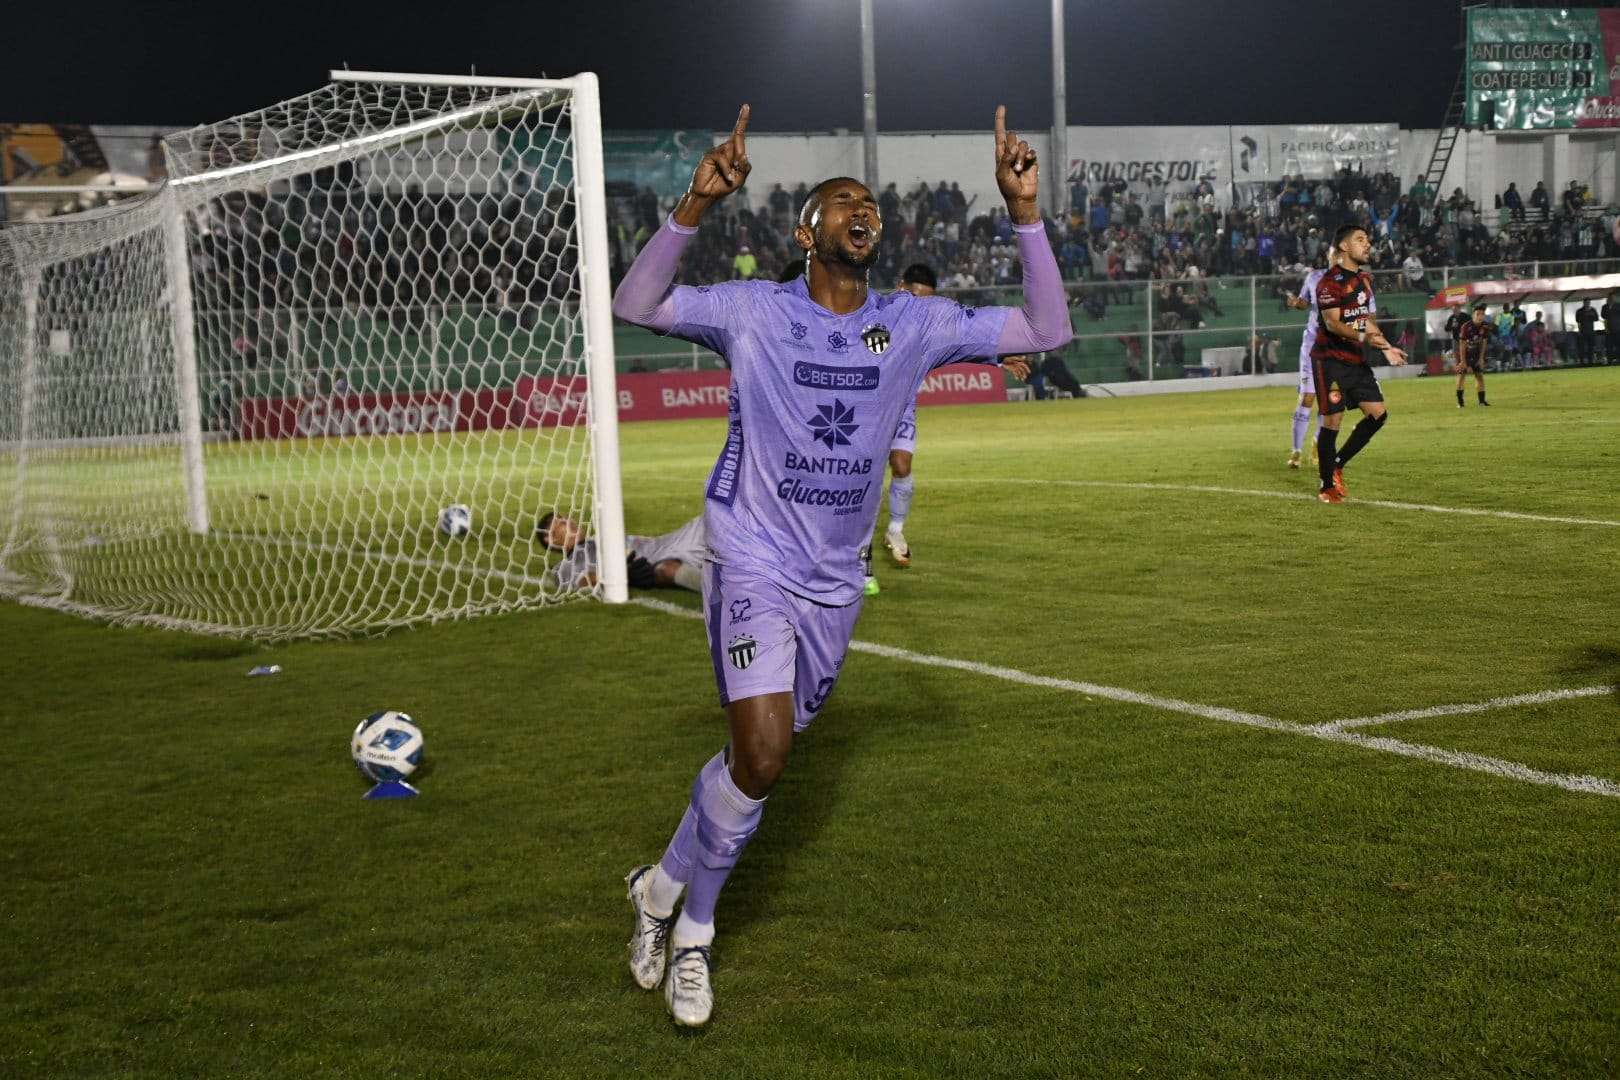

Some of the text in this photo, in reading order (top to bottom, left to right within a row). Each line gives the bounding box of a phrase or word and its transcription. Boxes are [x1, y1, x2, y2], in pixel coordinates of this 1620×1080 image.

[1281, 142, 1333, 153] PACIFIC
[1344, 306, 1369, 317] BANTR
[917, 372, 992, 394] ANTRAB
[531, 390, 634, 414] BANTB
[661, 385, 730, 408] BANTR
[784, 451, 873, 476] BANTRAB
[777, 478, 872, 507] Glucosoral
